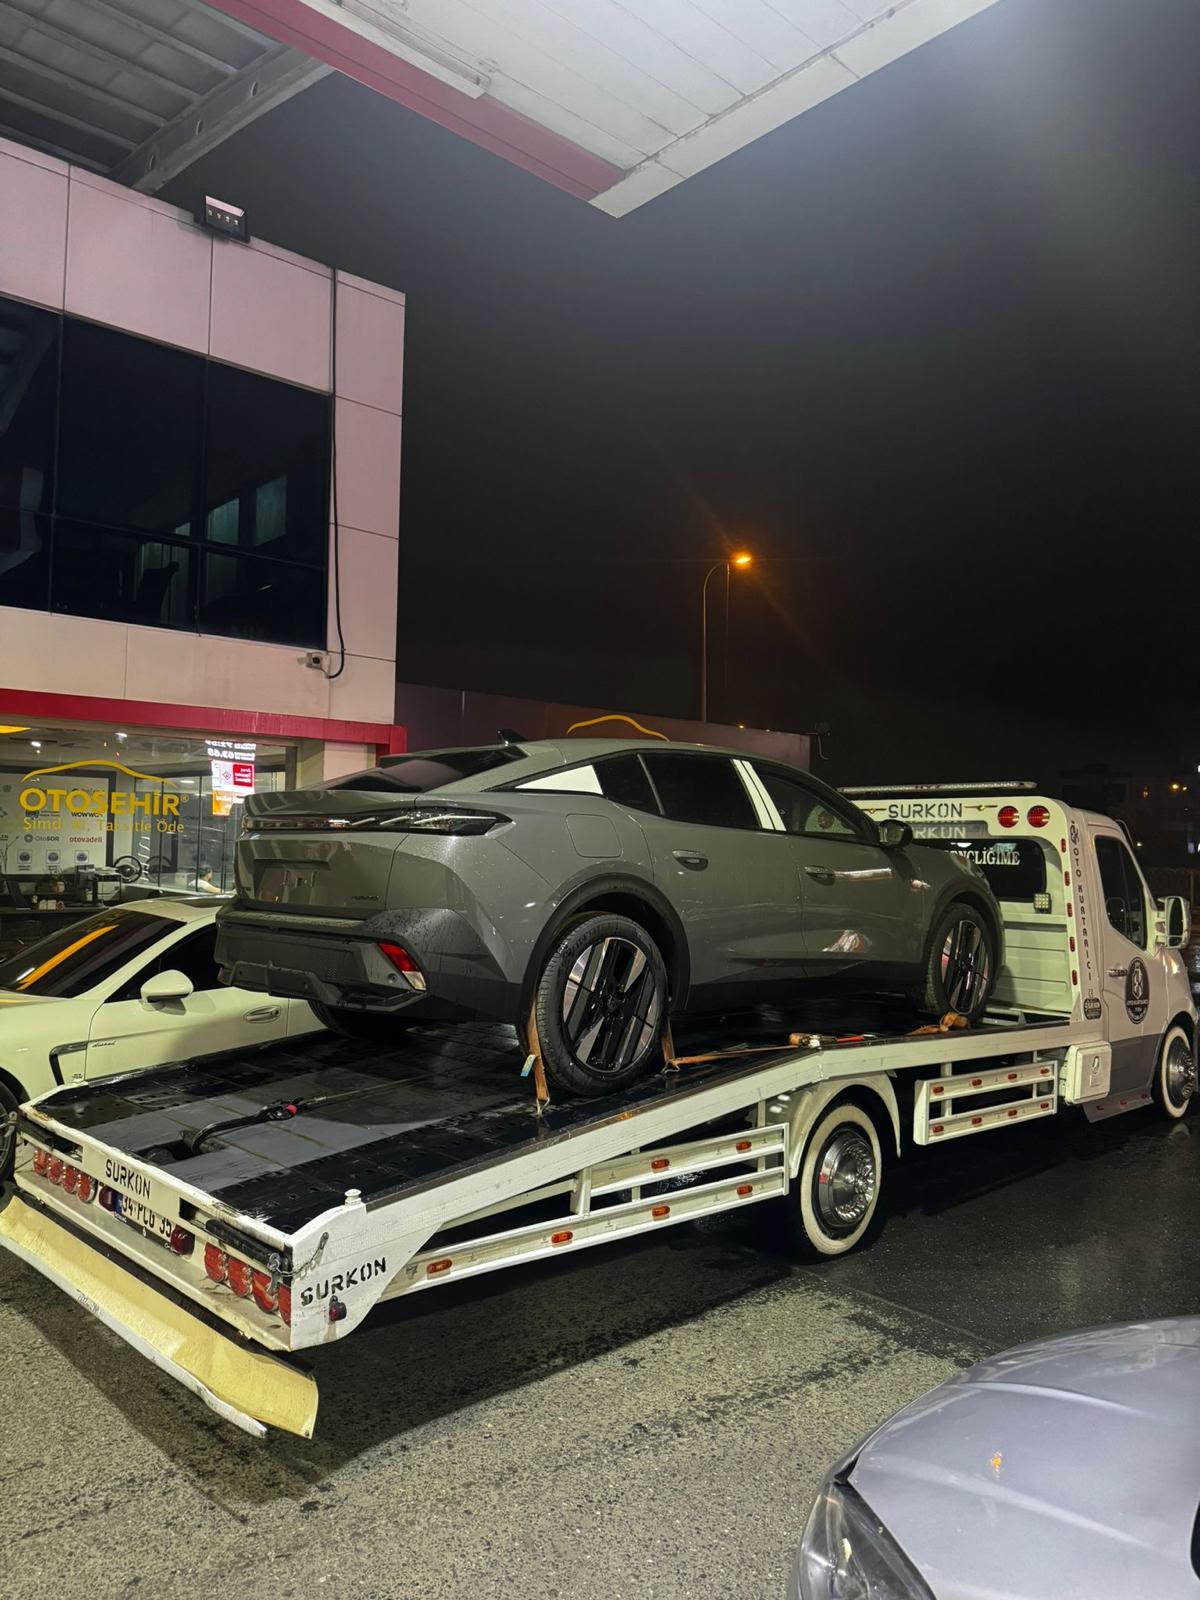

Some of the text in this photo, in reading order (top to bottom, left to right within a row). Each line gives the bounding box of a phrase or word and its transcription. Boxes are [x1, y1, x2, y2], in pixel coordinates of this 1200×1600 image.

[888, 803, 963, 819] SURKON
[156, 818, 185, 833] Öde
[105, 1158, 150, 1199] SURKON
[300, 1257, 386, 1307] SURKON
